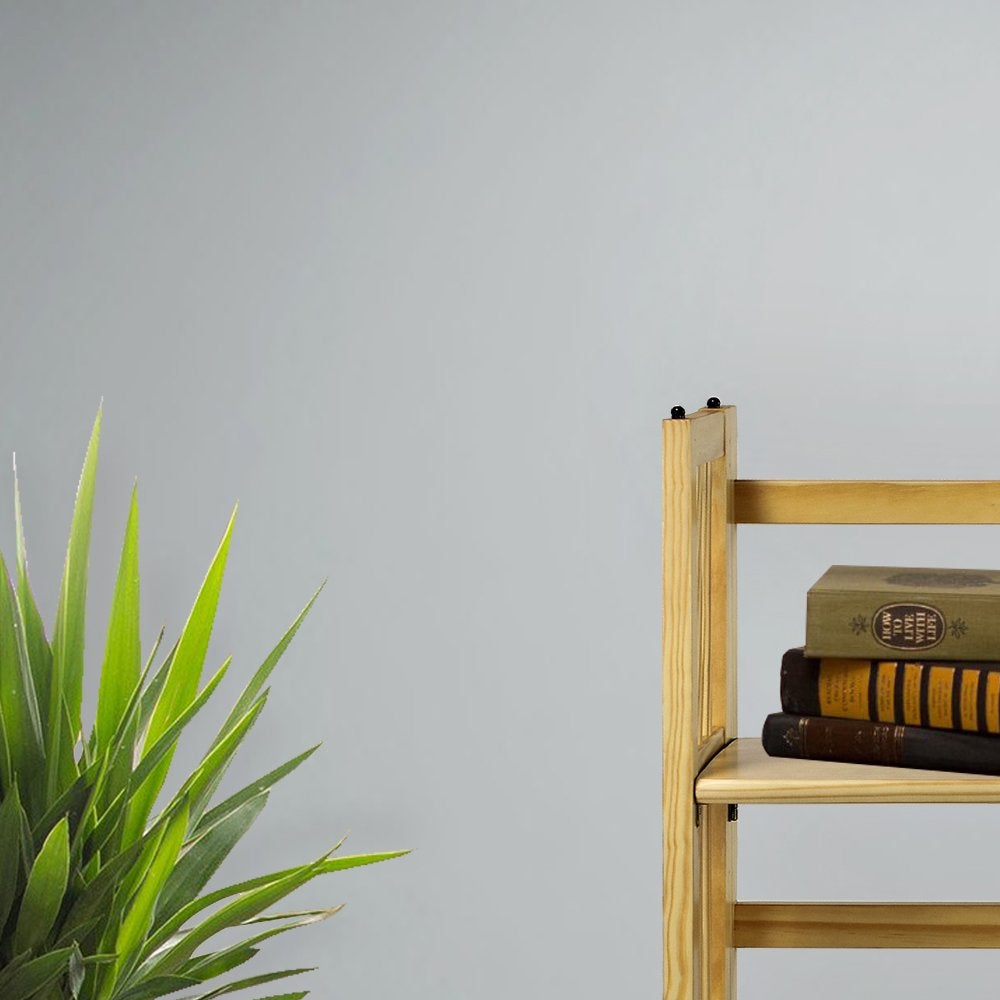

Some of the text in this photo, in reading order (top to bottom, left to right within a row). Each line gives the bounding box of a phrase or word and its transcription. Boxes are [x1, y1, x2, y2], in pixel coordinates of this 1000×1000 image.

[882, 611, 891, 639] HOW
[893, 618, 902, 636] TO
[904, 614, 914, 640] LIVE
[916, 612, 925, 643] WITH
[927, 613, 936, 640] LIFE
